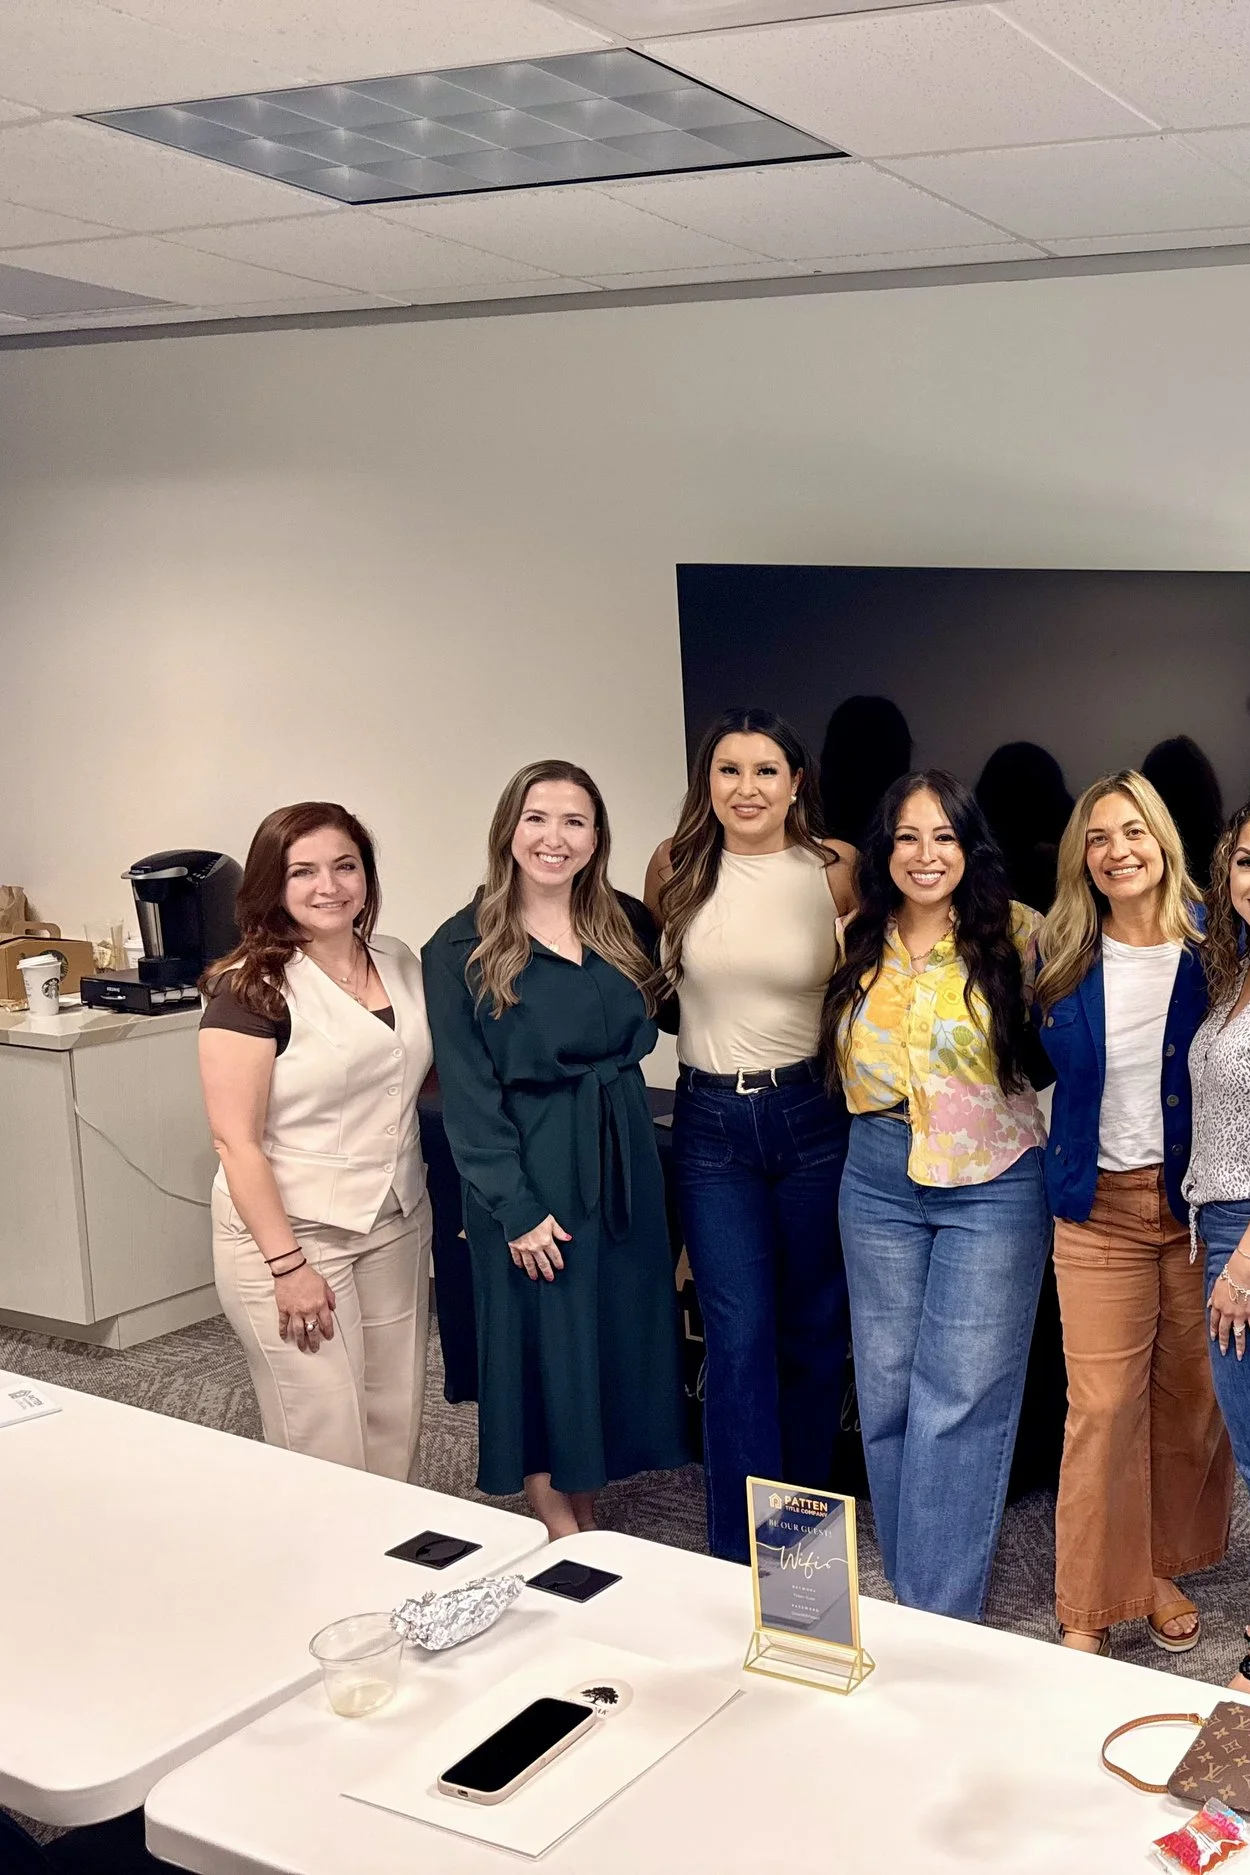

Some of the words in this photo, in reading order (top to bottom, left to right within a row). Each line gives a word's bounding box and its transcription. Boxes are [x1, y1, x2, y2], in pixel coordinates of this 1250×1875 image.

[785, 1496, 828, 1512] PATTEN
[801, 1509, 828, 1517] COMPANY
[780, 1522, 799, 1532] OUR
[775, 1542, 831, 1579] Wifi
